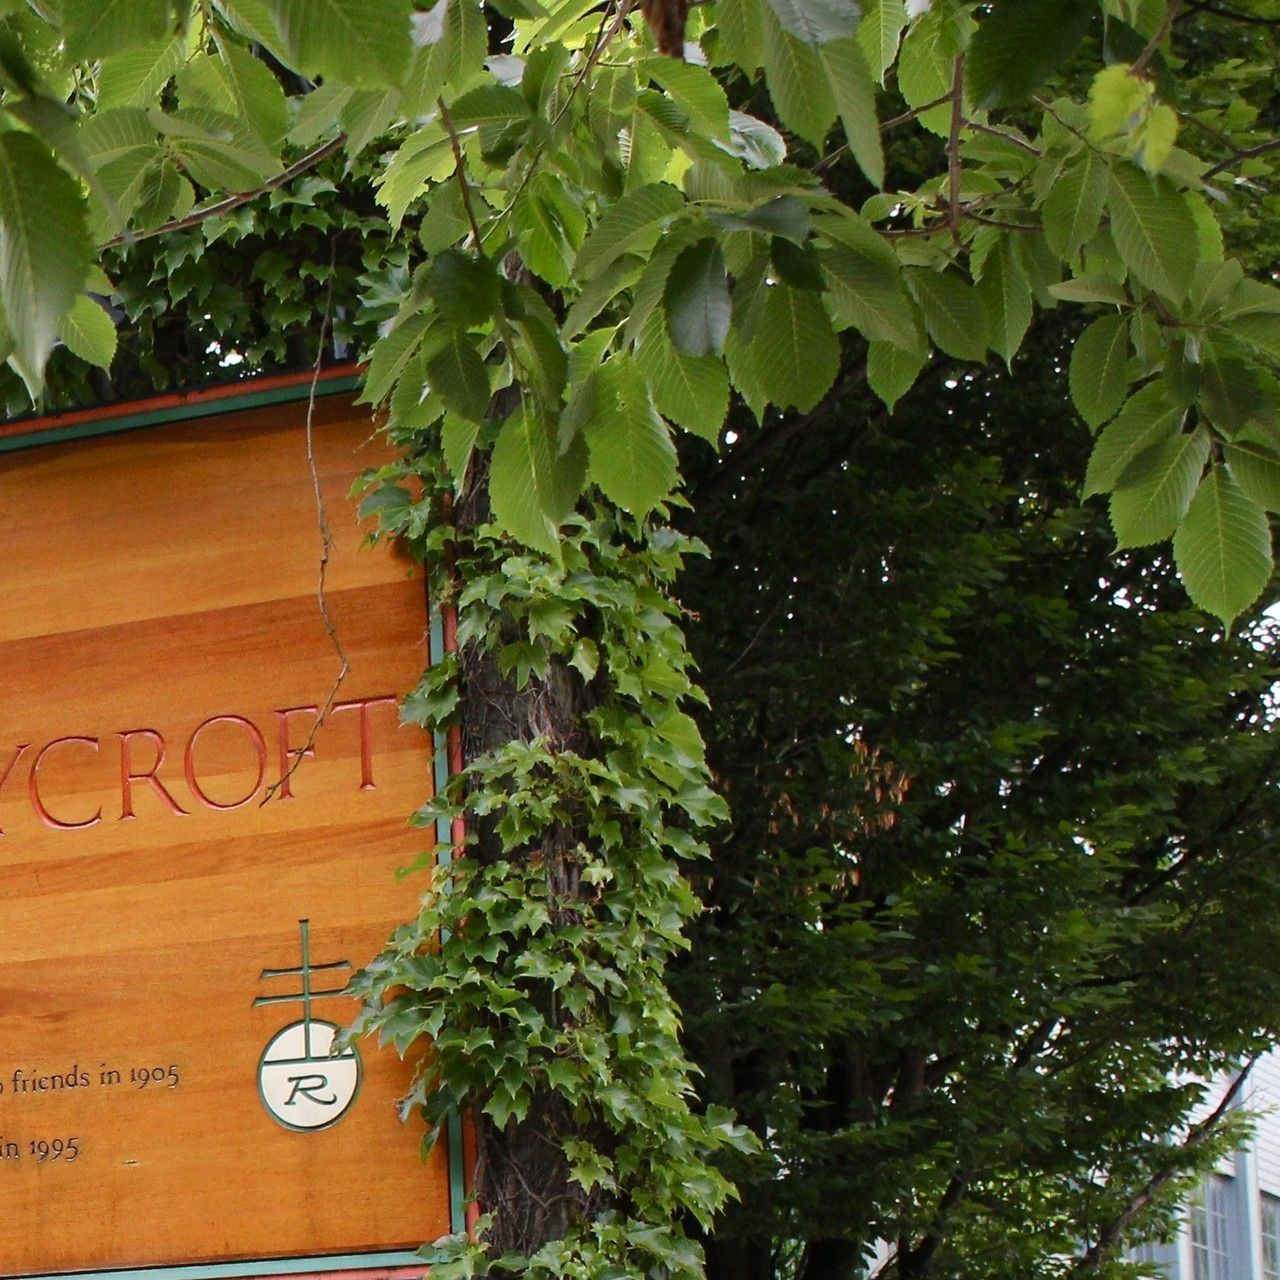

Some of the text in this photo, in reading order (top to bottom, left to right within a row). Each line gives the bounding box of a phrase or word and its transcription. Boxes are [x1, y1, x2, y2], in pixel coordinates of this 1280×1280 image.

[11, 1065, 91, 1095] friends
[99, 1063, 122, 1087] in
[130, 1064, 181, 1090] 1905
[29, 1137, 81, 1163] 1995
